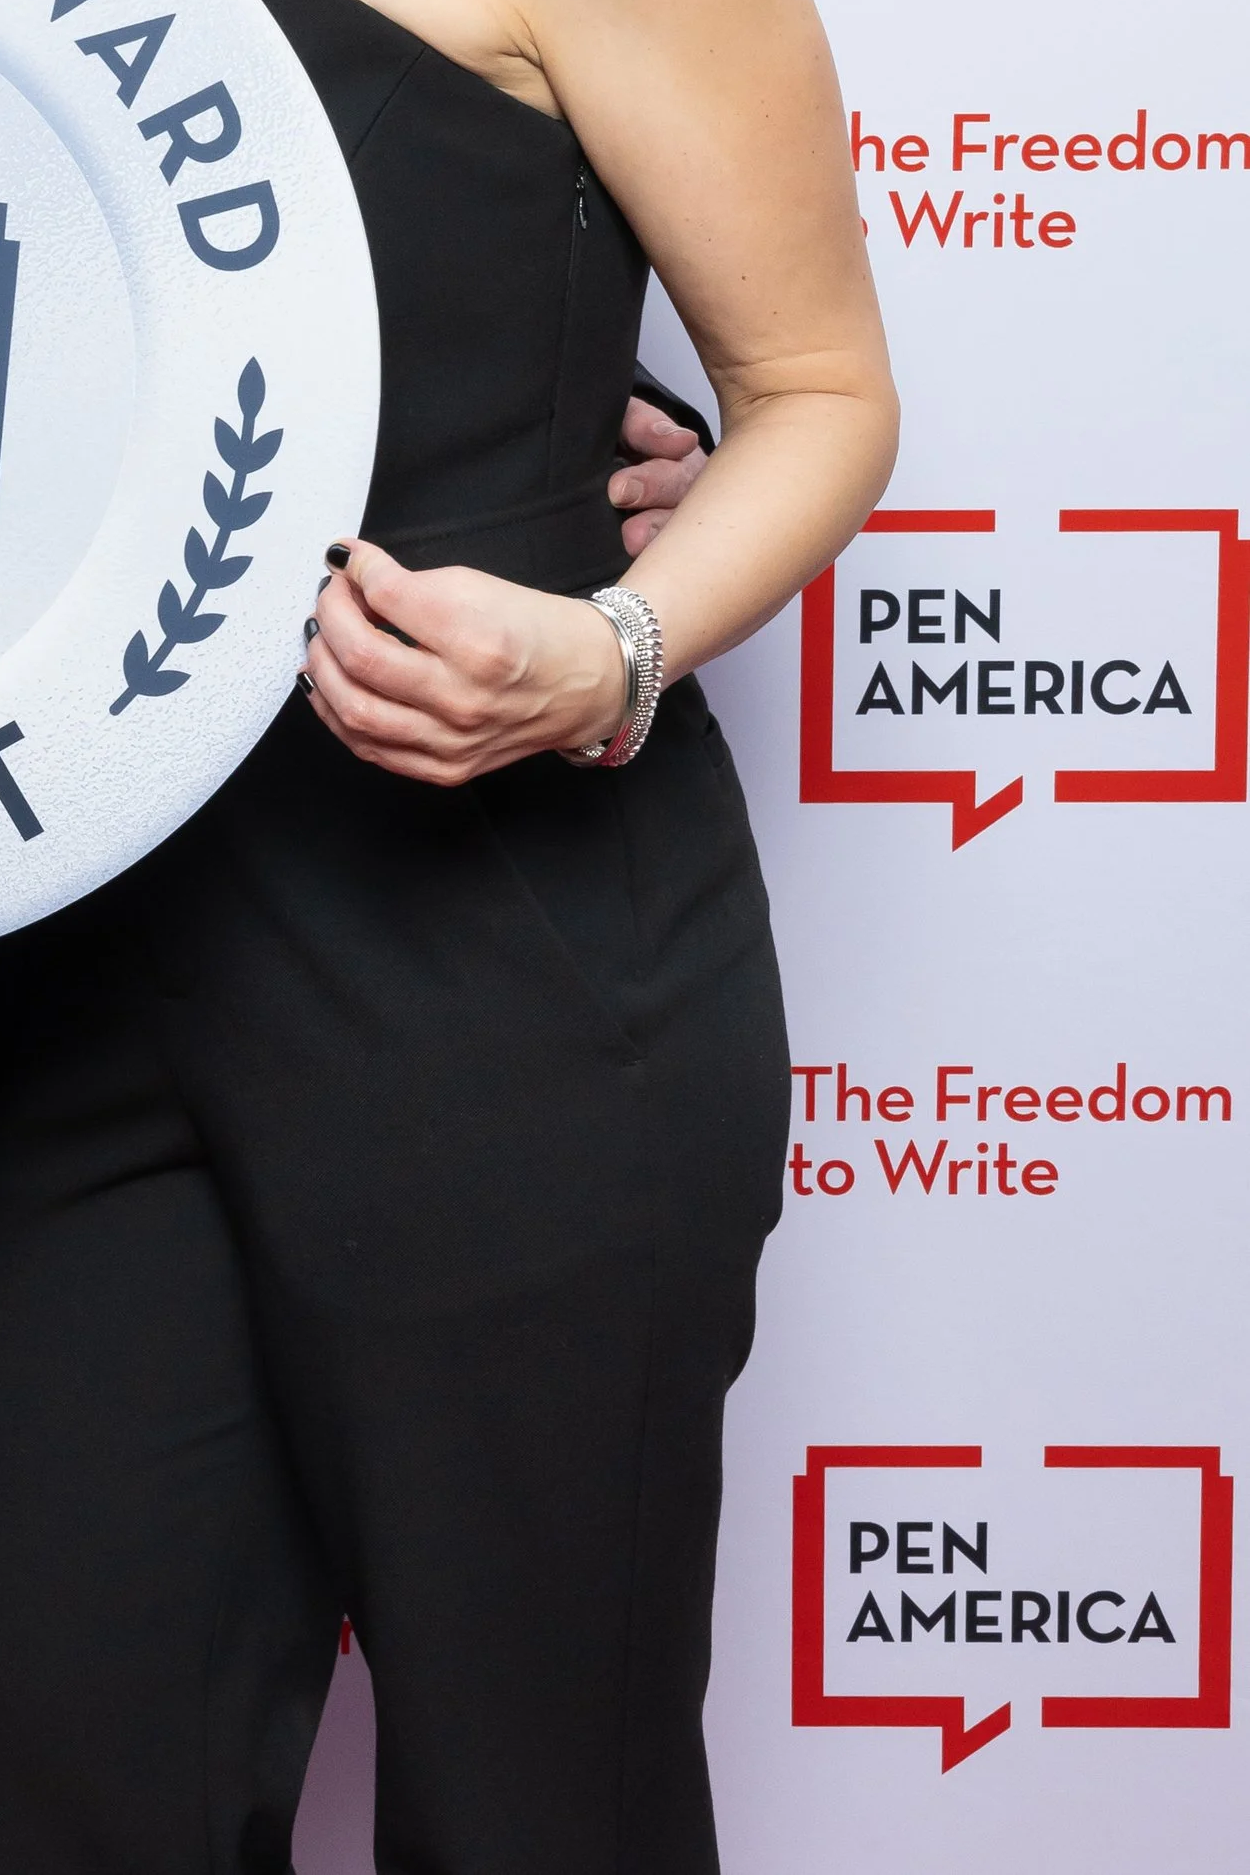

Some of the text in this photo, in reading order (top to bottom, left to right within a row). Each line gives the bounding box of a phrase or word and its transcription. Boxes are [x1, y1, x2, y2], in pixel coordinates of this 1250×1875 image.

[851, 111, 929, 172] he
[889, 190, 1076, 248] Write
[860, 589, 1000, 644] PEN
[856, 660, 1192, 715] AMERICA
[791, 1063, 1231, 1122] The Freedom
[789, 1140, 1058, 1196] to Write
[850, 1522, 987, 1574] PEN
[846, 1590, 1176, 1643] AMERICA
